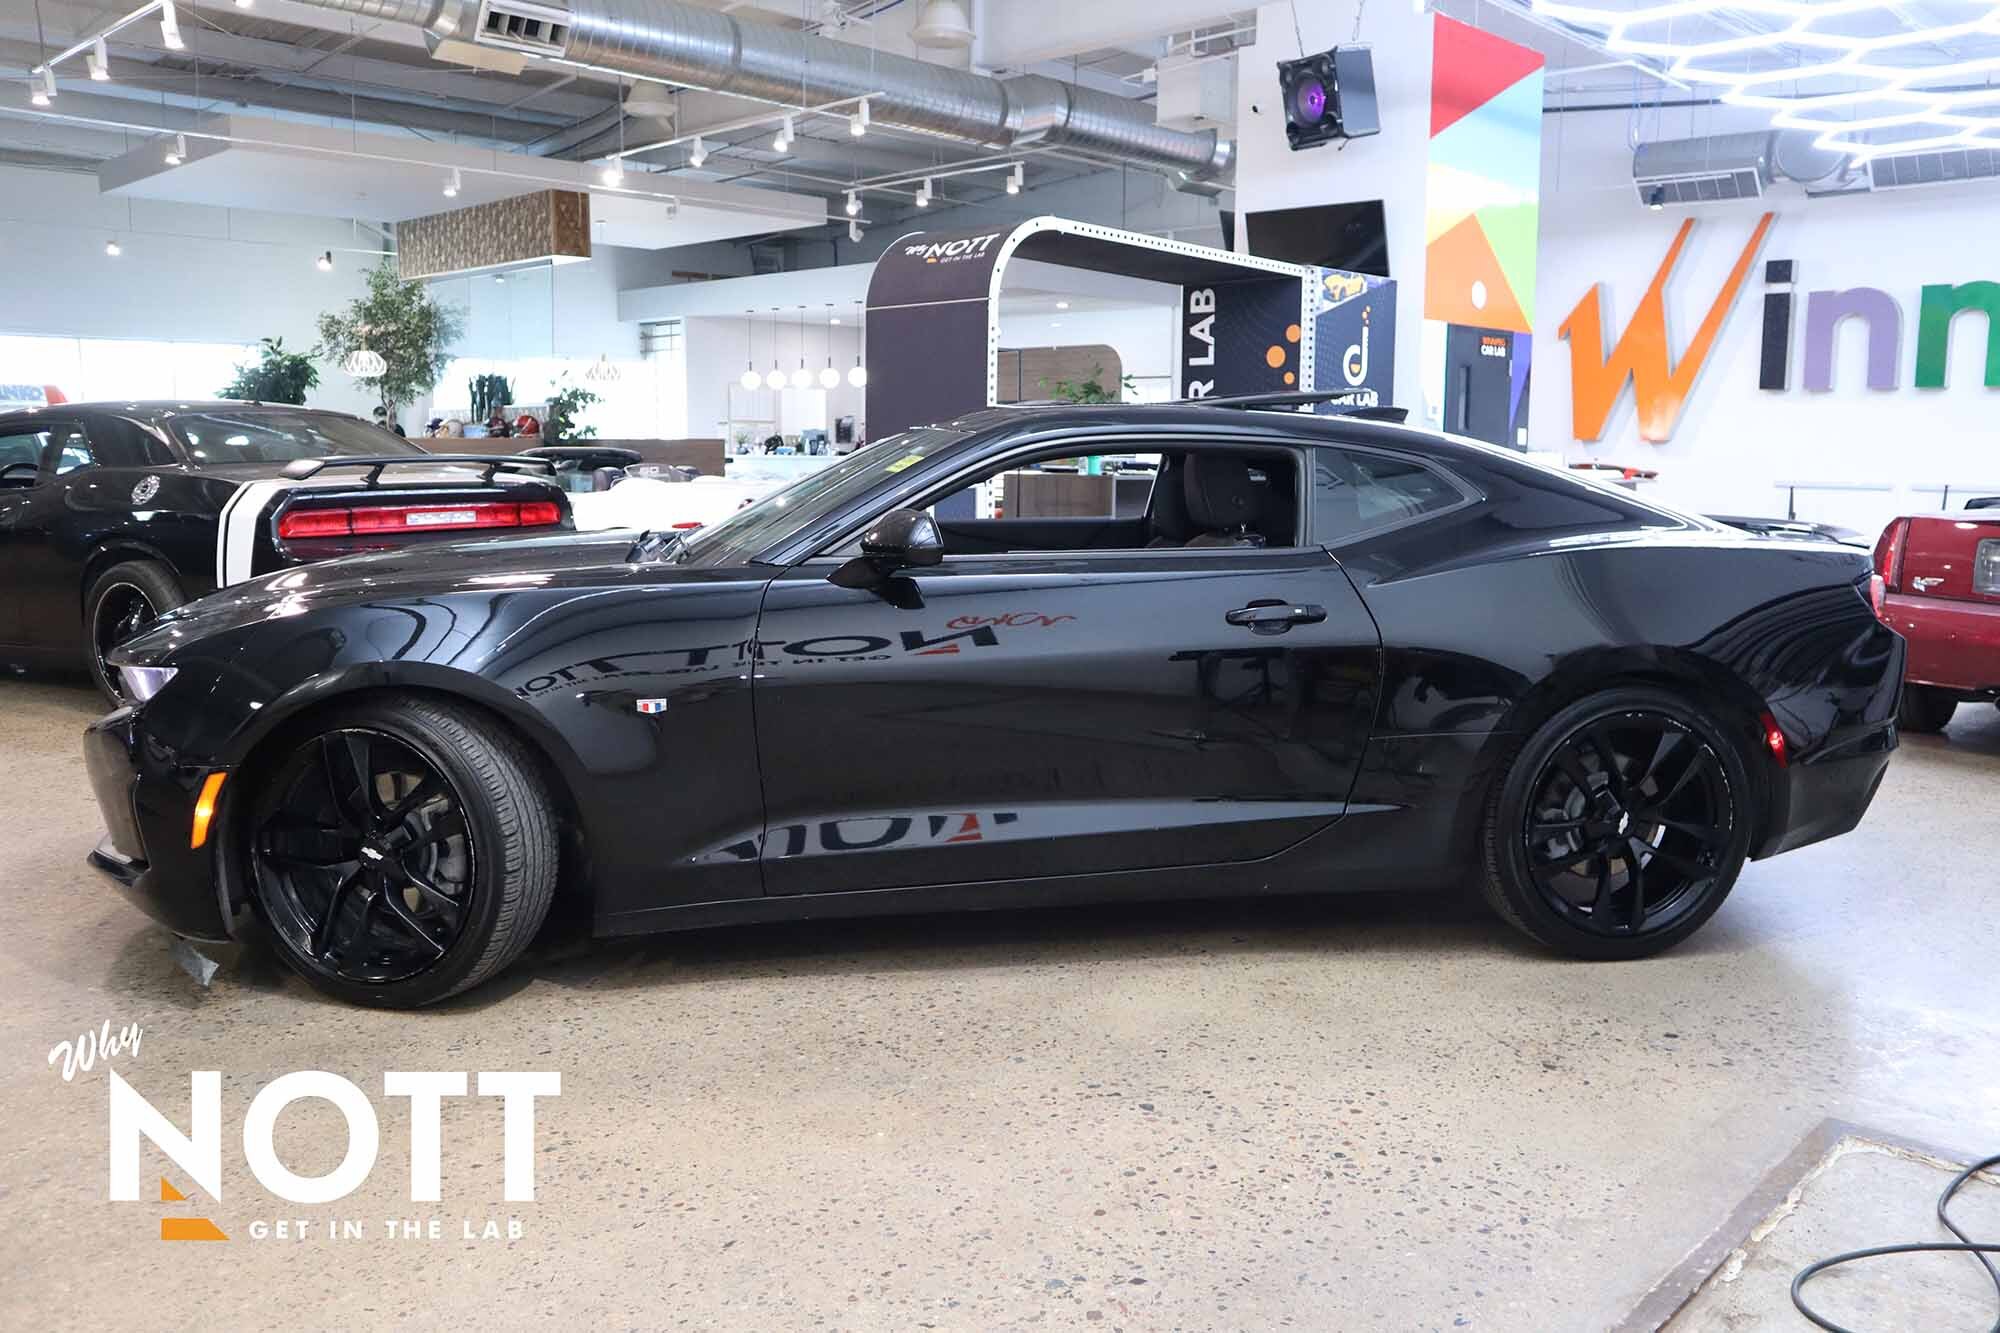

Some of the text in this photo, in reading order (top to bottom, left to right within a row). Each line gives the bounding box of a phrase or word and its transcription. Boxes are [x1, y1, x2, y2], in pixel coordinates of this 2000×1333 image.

[923, 232, 1001, 259] NOTT
[1188, 287, 1216, 367] LAB
[1557, 211, 2000, 441] Winn
[1356, 389, 1379, 408] LAB
